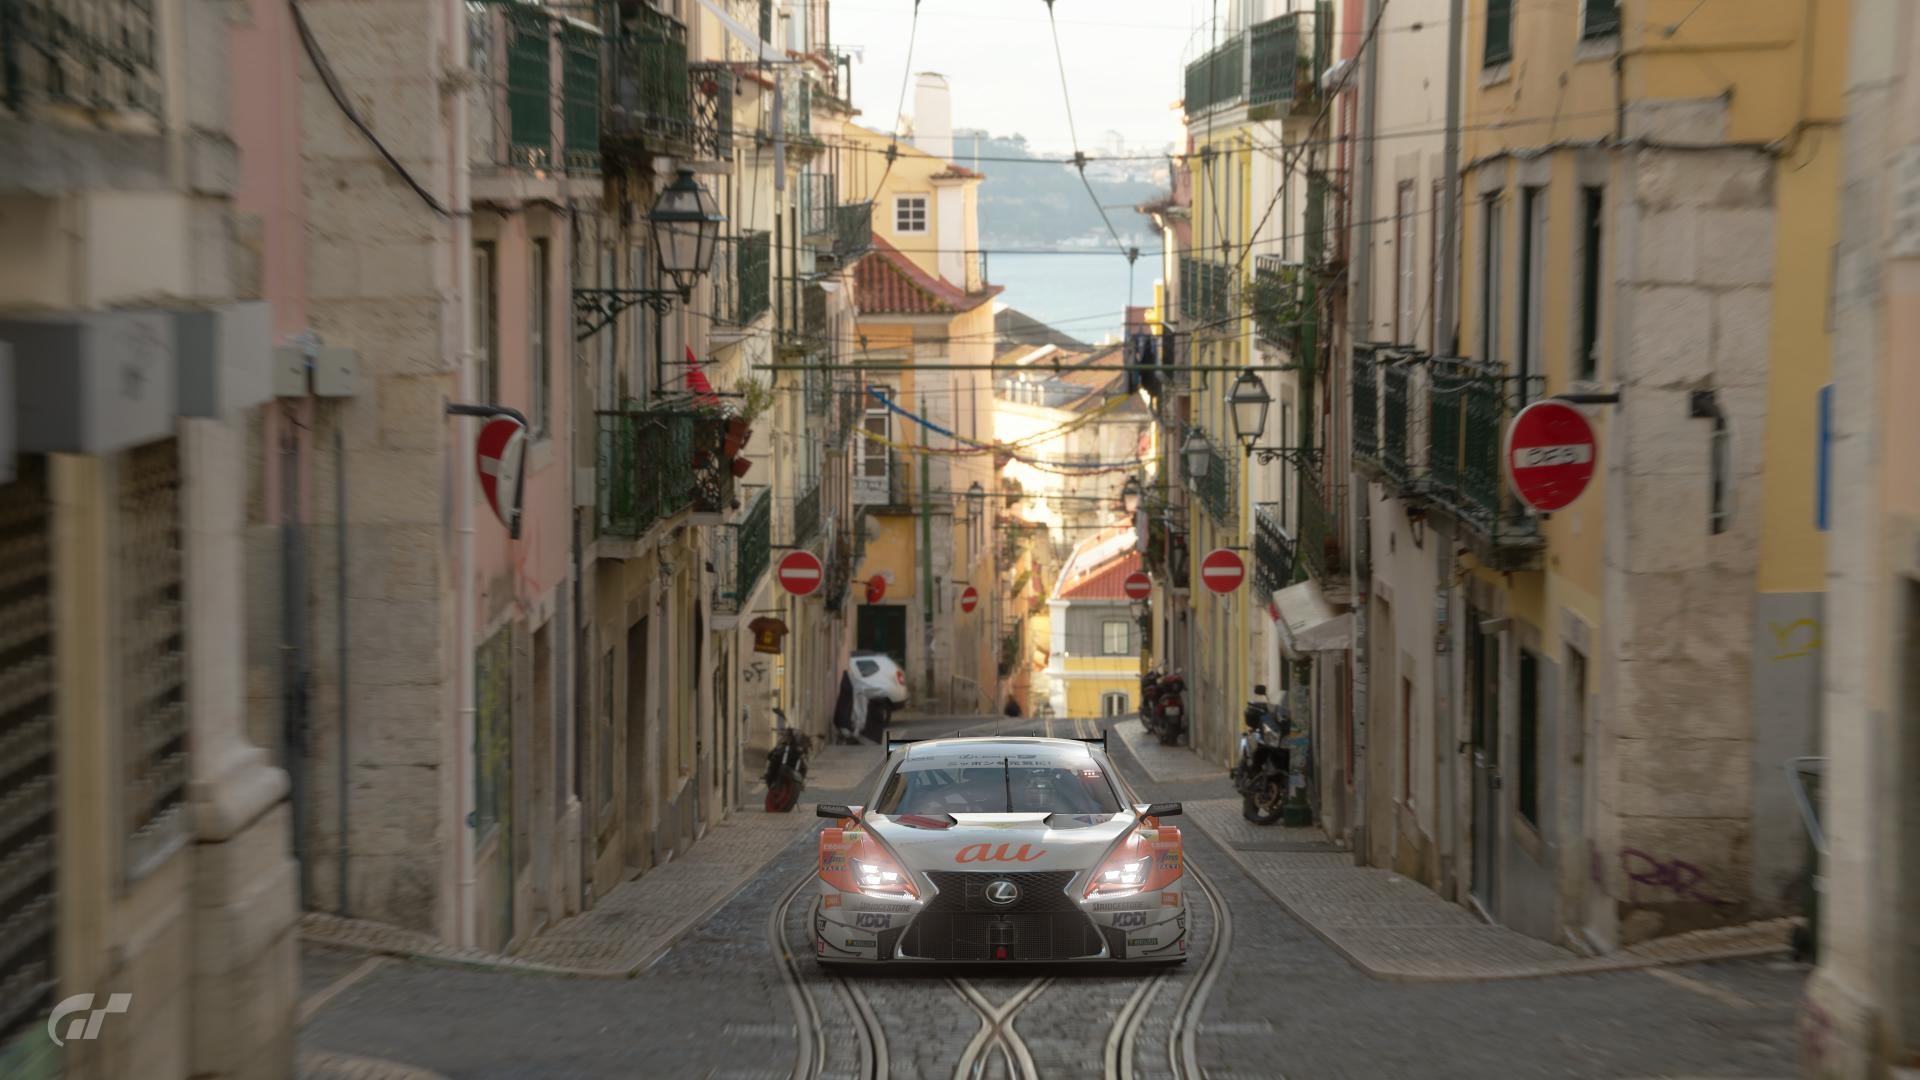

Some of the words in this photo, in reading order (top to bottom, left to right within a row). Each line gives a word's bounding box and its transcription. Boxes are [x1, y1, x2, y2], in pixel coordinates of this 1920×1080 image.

[954, 842, 1048, 864] au
[856, 913, 891, 928] KDDI
[1112, 911, 1147, 927] KDDI
